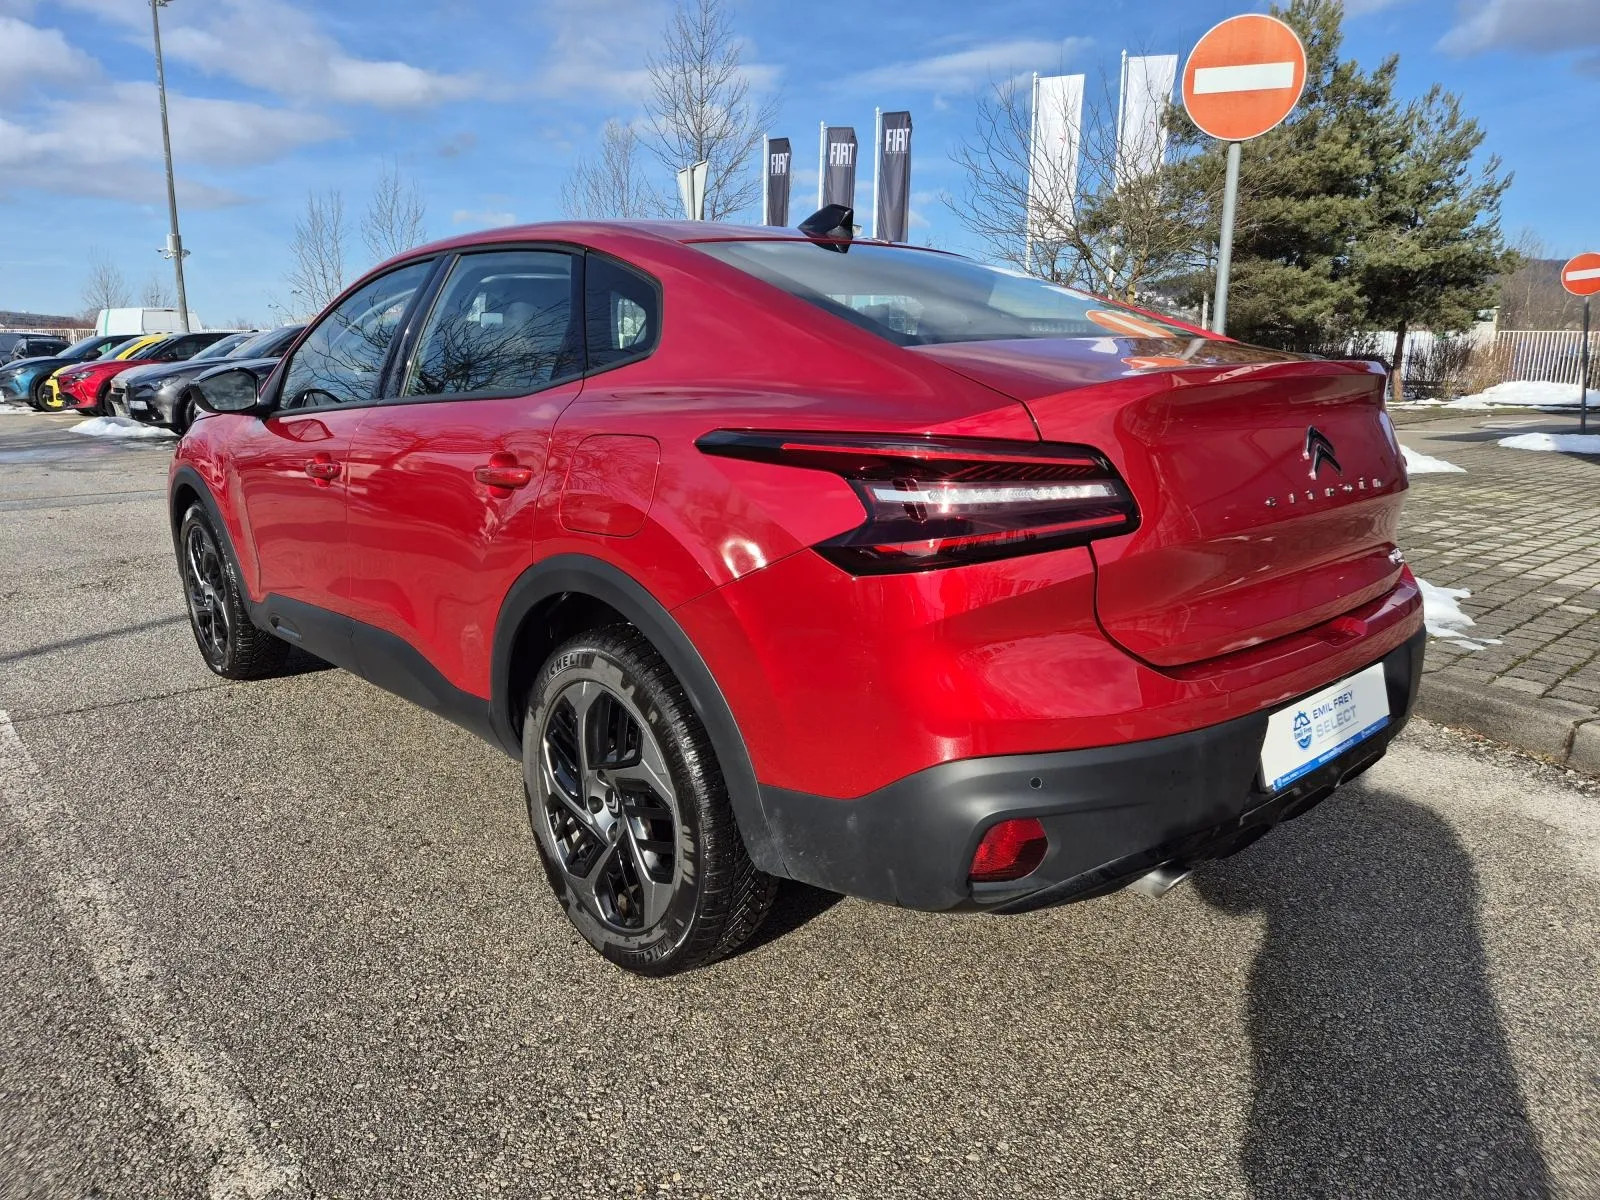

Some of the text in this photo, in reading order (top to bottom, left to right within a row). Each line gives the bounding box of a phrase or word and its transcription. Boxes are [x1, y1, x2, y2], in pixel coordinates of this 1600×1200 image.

[885, 128, 910, 152] FIAT
[770, 152, 790, 174] FIAT
[829, 142, 855, 165] FIAT
[1312, 690, 1354, 720] EMIL FREY
[1315, 704, 1357, 738] SELECT
